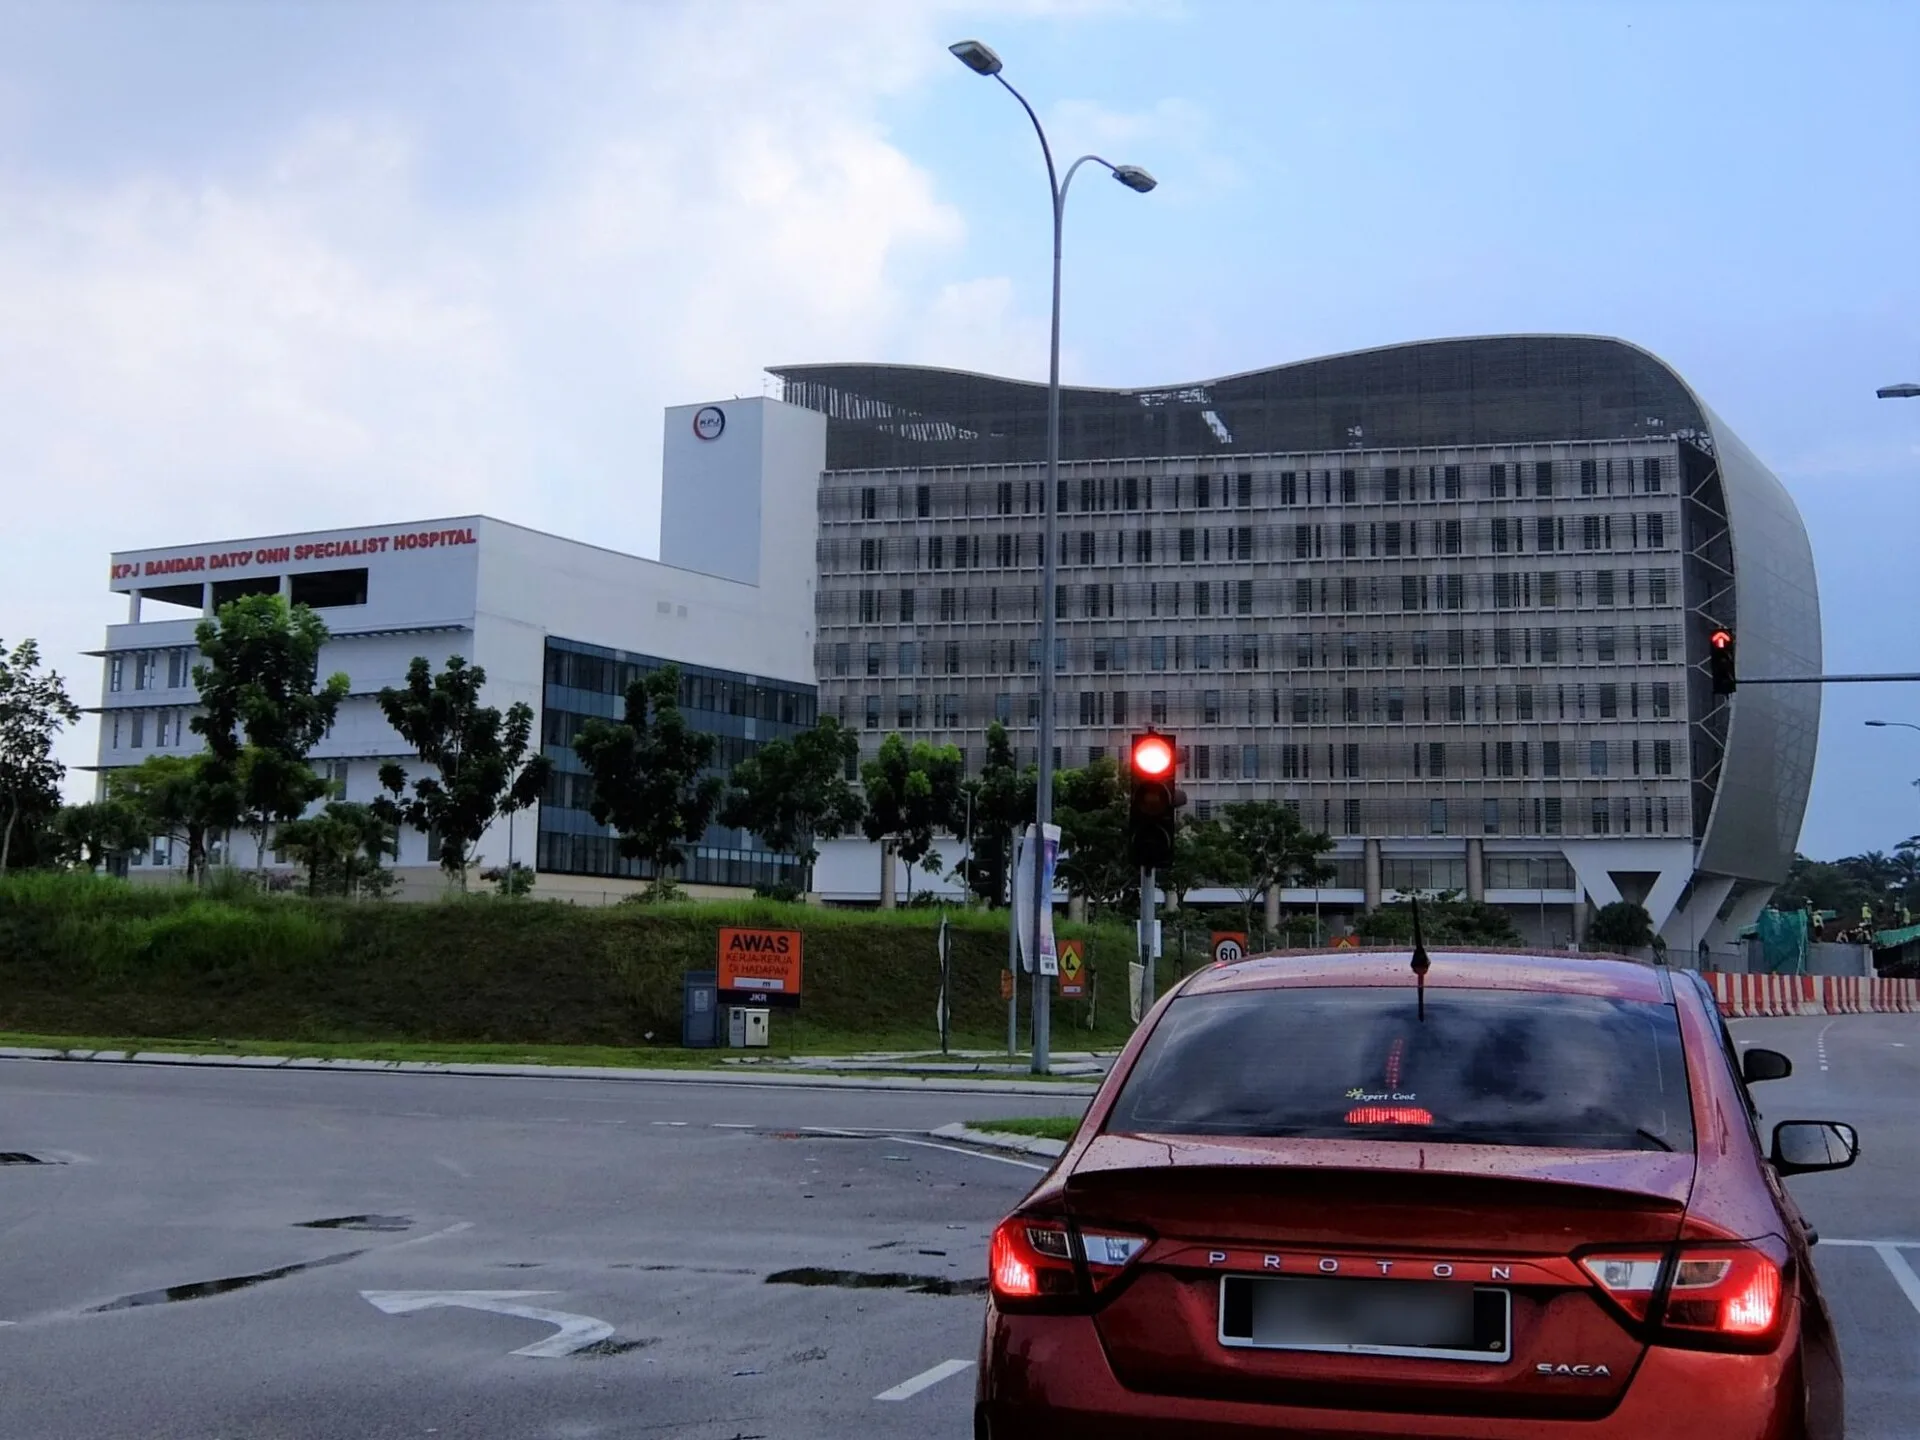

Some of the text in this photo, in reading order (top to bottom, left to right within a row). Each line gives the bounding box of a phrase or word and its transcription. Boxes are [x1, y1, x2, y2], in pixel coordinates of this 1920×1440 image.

[111, 529, 477, 580] KPJ BANDAR DATO' ONN SPECIALIST HOSPITAL
[730, 934, 789, 954] AWAS
[1220, 947, 1237, 961] 60
[741, 965, 788, 975] HADAPAN
[749, 993, 767, 1002] JKR
[1355, 1093, 1388, 1102] Expert
[1208, 1251, 1511, 1279] PROTON
[1535, 1362, 1611, 1377] SAGA
